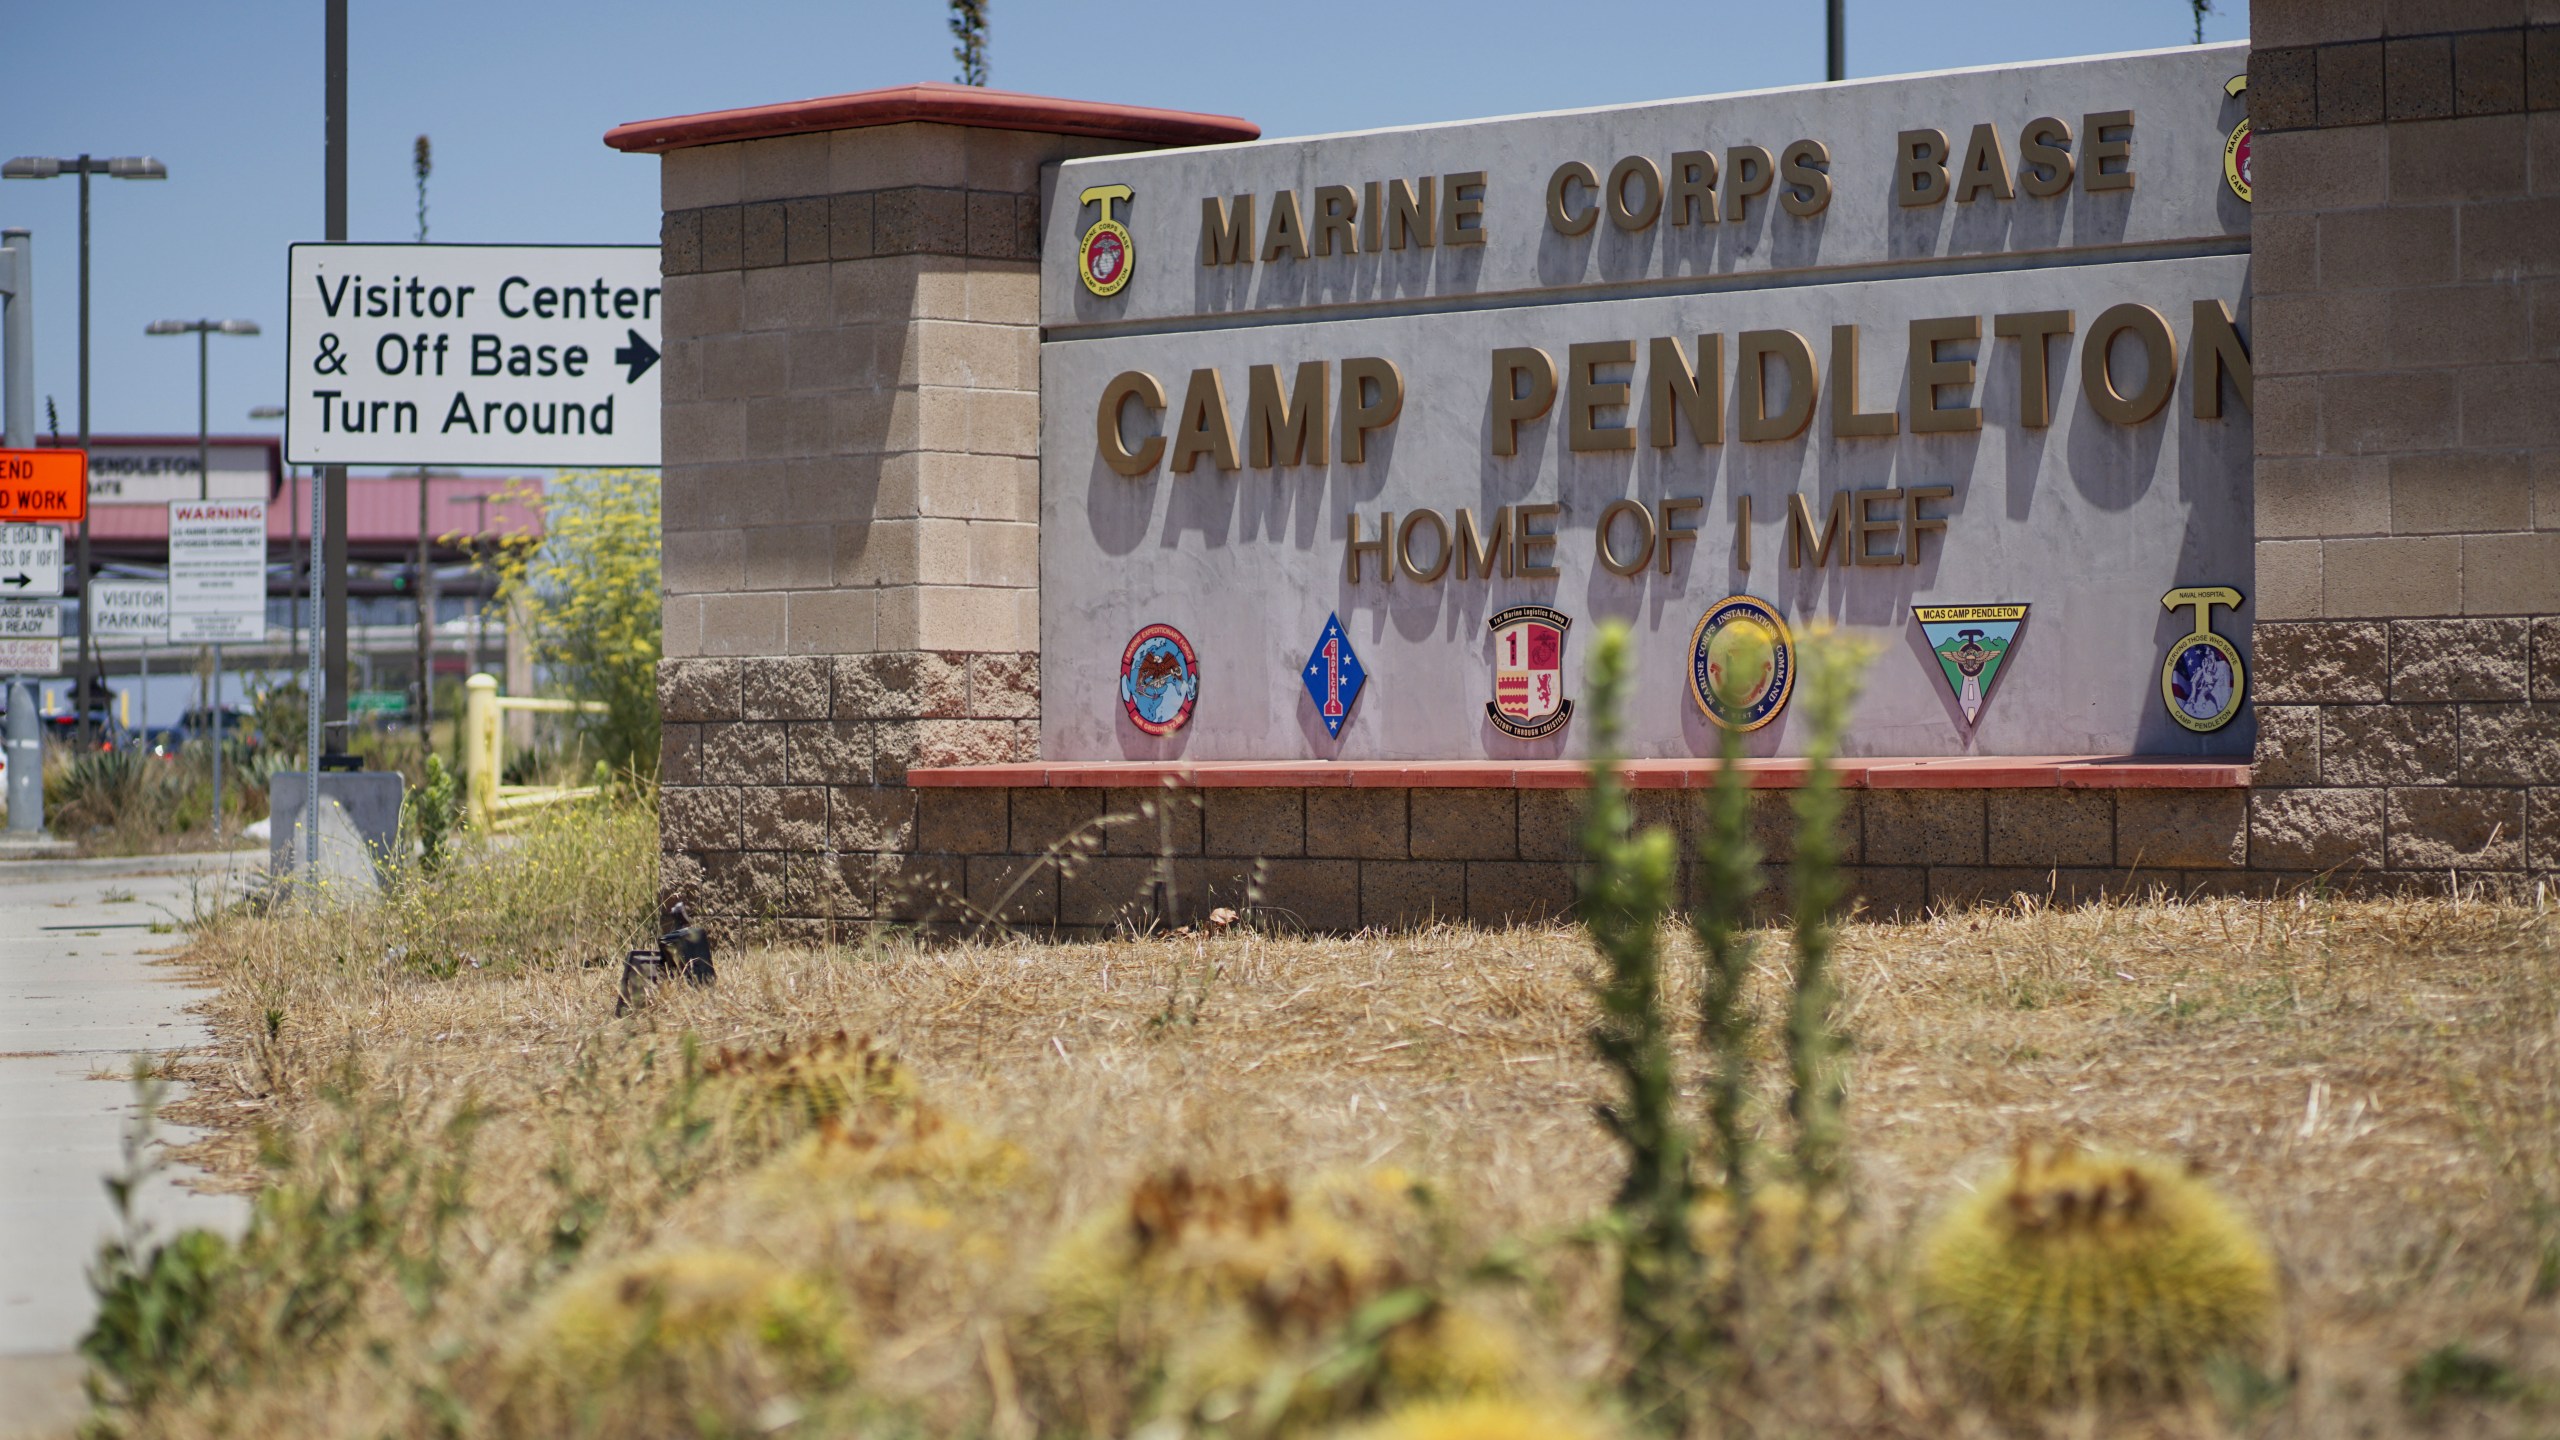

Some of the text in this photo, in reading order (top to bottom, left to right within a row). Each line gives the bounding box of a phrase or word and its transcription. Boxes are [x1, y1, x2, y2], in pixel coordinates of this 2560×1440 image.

[2226, 123, 2248, 154] MARINE
[1202, 109, 2135, 266] MARINE CORPS BASE
[2230, 174, 2248, 195] CAMP
[1081, 222, 1130, 255] MARINE CORPS BASE
[1083, 267, 1129, 293] CAMP PENDLETON
[316, 274, 661, 319] Visitor Center
[313, 332, 588, 377] & Off Base
[1097, 299, 2252, 476] CAMP PENDLETON
[313, 390, 613, 435] Turn Around
[0, 460, 33, 479] END
[17, 490, 67, 510] WORK
[176, 506, 262, 520] WARNING
[12, 527, 37, 544] LOAD
[42, 528, 53, 544] IN
[1347, 485, 1953, 583] HOME OF I MEF
[19, 549, 31, 567] OF
[103, 591, 163, 607] VISITOR
[26, 607, 54, 618] HAVE
[98, 612, 168, 628] PARKING
[1494, 607, 1565, 625] 1st Marine Logistics Group
[1923, 607, 2019, 619] MCAS CAMP PENDLETON
[6, 620, 42, 632] READY
[20, 642, 52, 655] CHECK
[1127, 634, 1141, 657] MARINE
[1141, 626, 1181, 640] EXPEDITIONARY
[1179, 640, 1193, 660] FORCE
[2167, 635, 2239, 668] SERVING THOSE WHO SERVE
[1697, 608, 1785, 706] MARINE CORPS INSTALLATIONS COMMAND
[1133, 715, 1184, 732] AIR GROUND TEAM
[1491, 711, 1567, 736] VICTORY THROUGH LOGISTICS
[2174, 709, 2233, 730] CAMP PENDLETON
